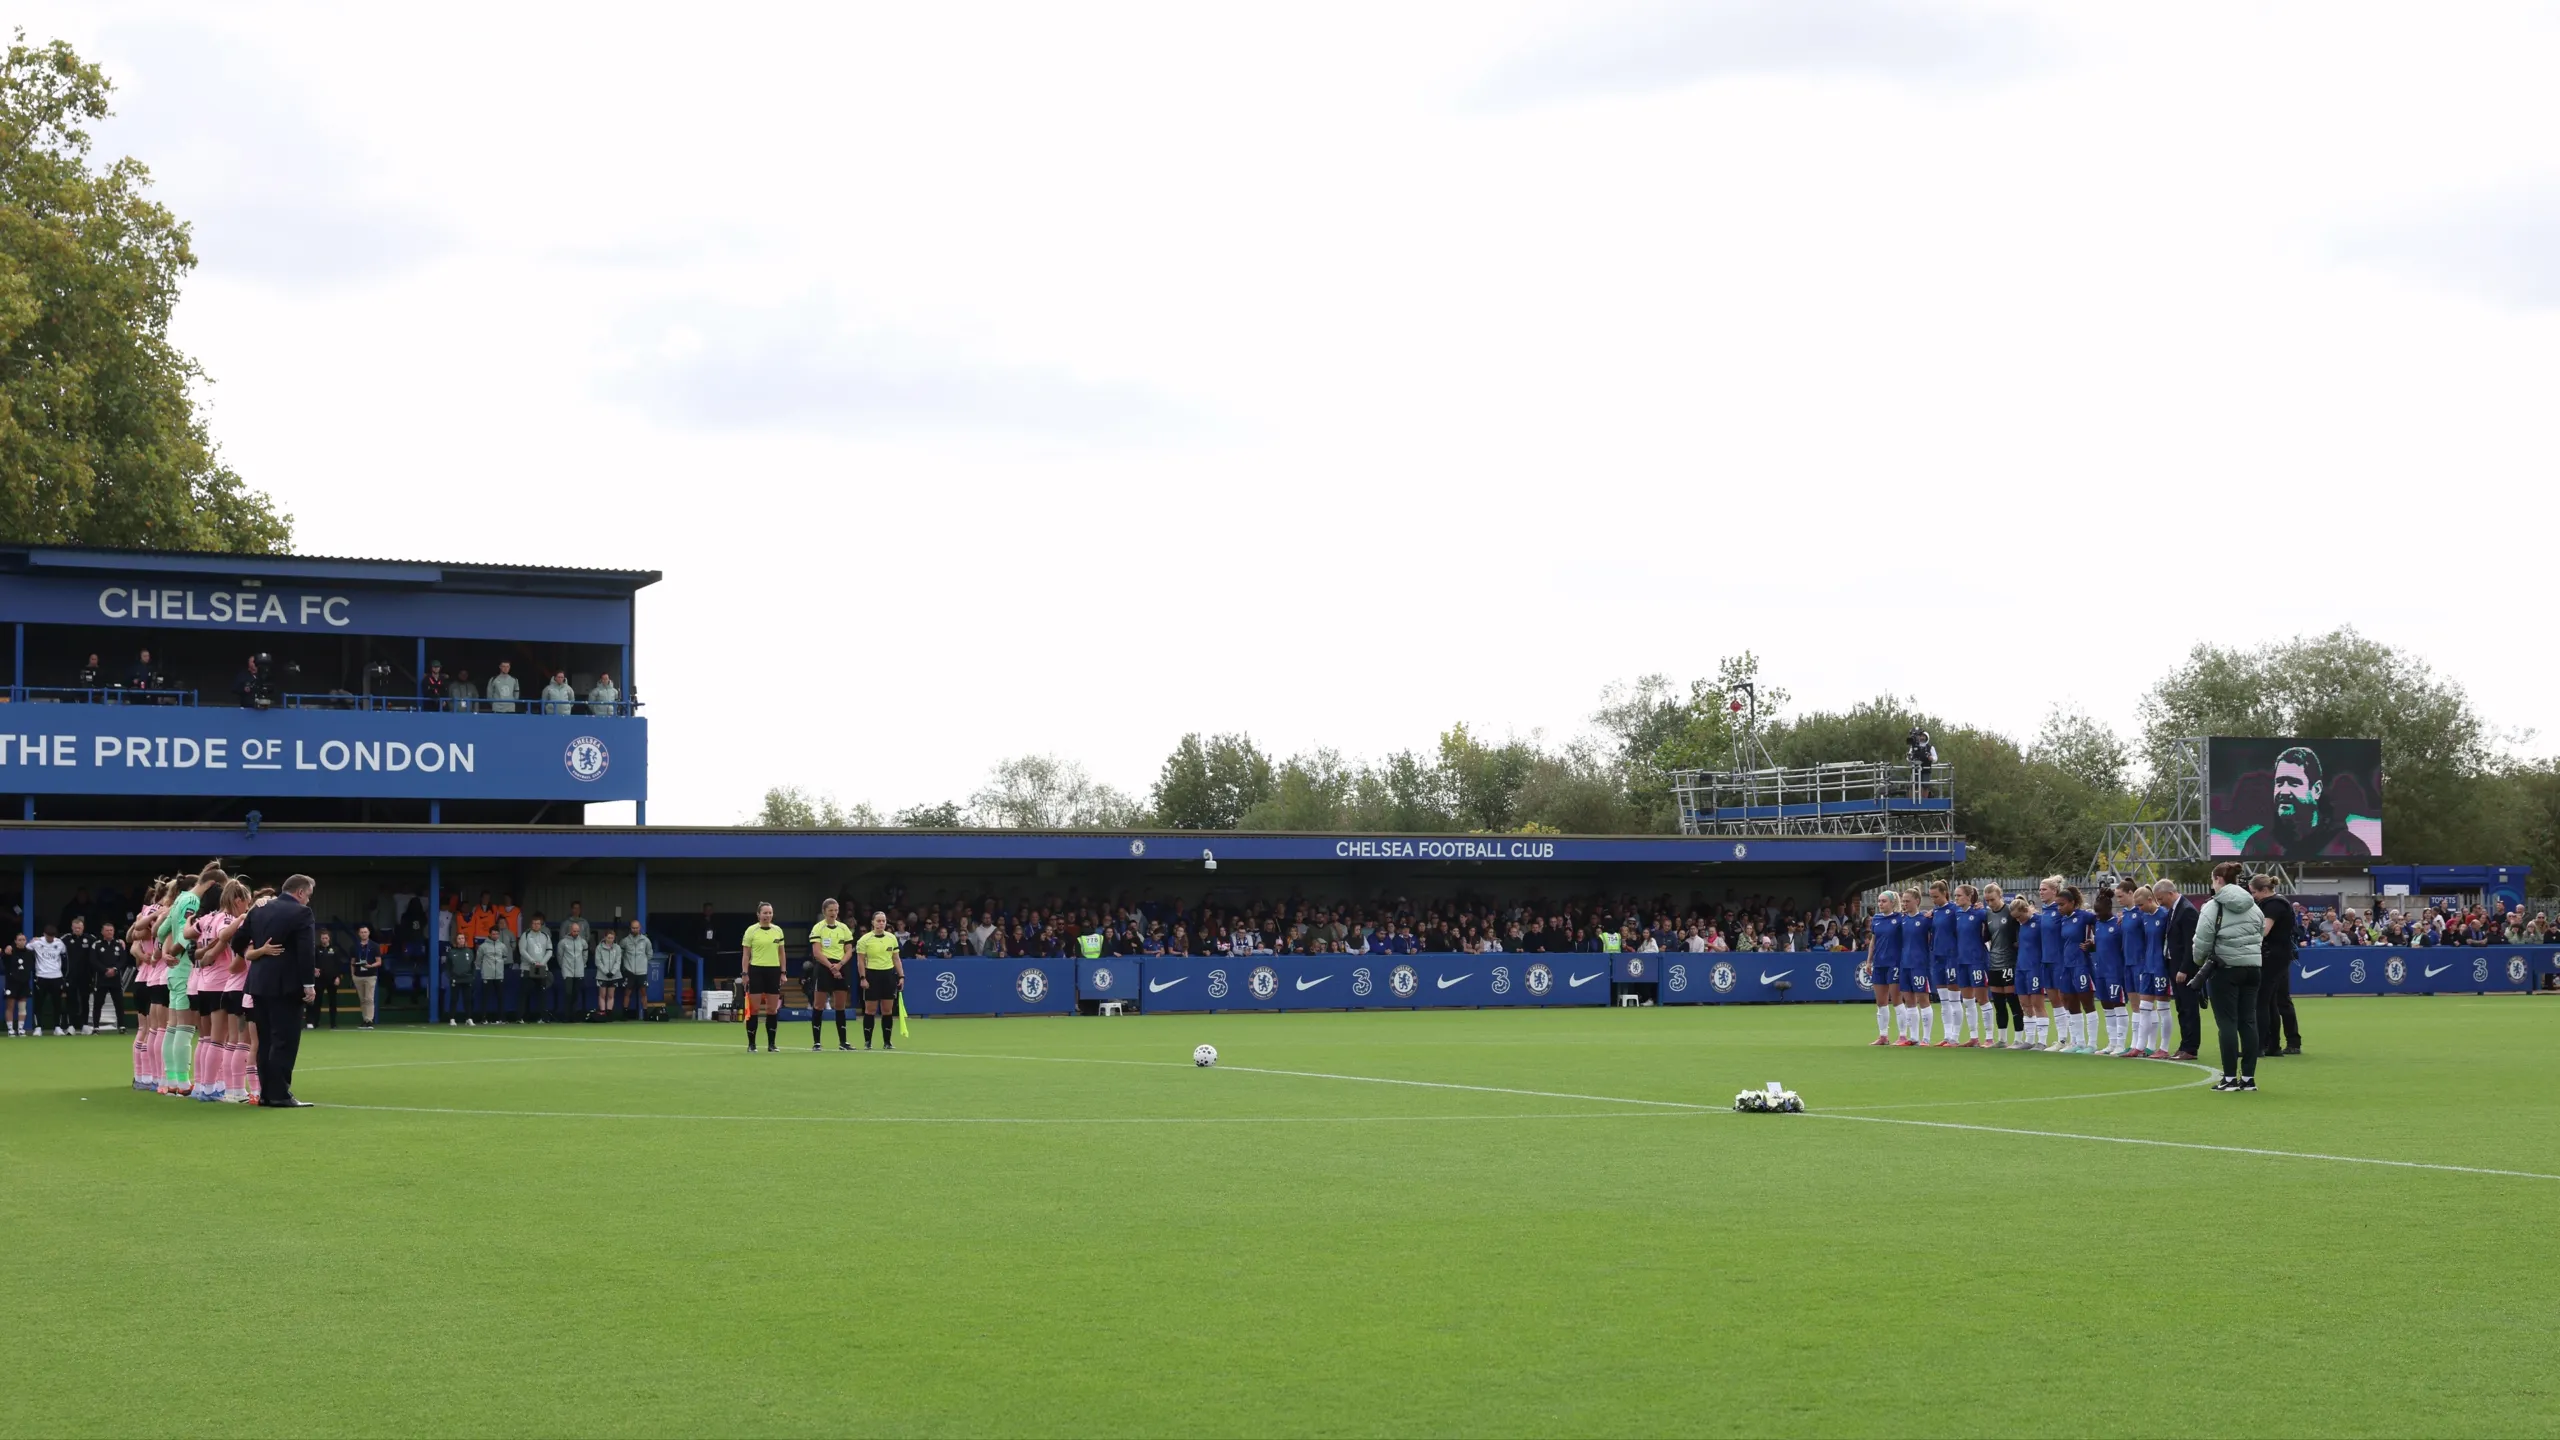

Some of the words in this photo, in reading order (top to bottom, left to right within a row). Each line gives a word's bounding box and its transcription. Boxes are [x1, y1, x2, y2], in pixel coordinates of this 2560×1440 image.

[98, 587, 288, 624] CHELSEA
[300, 596, 350, 627] FC
[0, 734, 77, 767] THE
[95, 736, 228, 769] PRIDE
[241, 738, 282, 760] OF
[295, 740, 474, 773] LONDON
[572, 738, 602, 749] CHELSEA
[1336, 841, 1414, 857] CHELSEA
[1419, 842, 1506, 858] FOOTBALL
[1510, 843, 1554, 858] CLUB
[1491, 966, 1511, 994] 3
[1669, 964, 1688, 991] 3
[1815, 963, 1833, 989] 3
[1946, 968, 1957, 979] 14
[1972, 969, 1983, 980] 18
[2002, 968, 2014, 979] 24
[2080, 974, 2087, 985] 9
[2350, 958, 2366, 983] 3
[2473, 957, 2488, 982] 3
[936, 971, 958, 1001] 3
[1208, 969, 1228, 998] 3
[1352, 967, 1372, 996] 3
[1913, 975, 1925, 986] 30
[2032, 976, 2039, 987] 8
[2109, 984, 2120, 996] 17
[2154, 976, 2167, 988] 33
